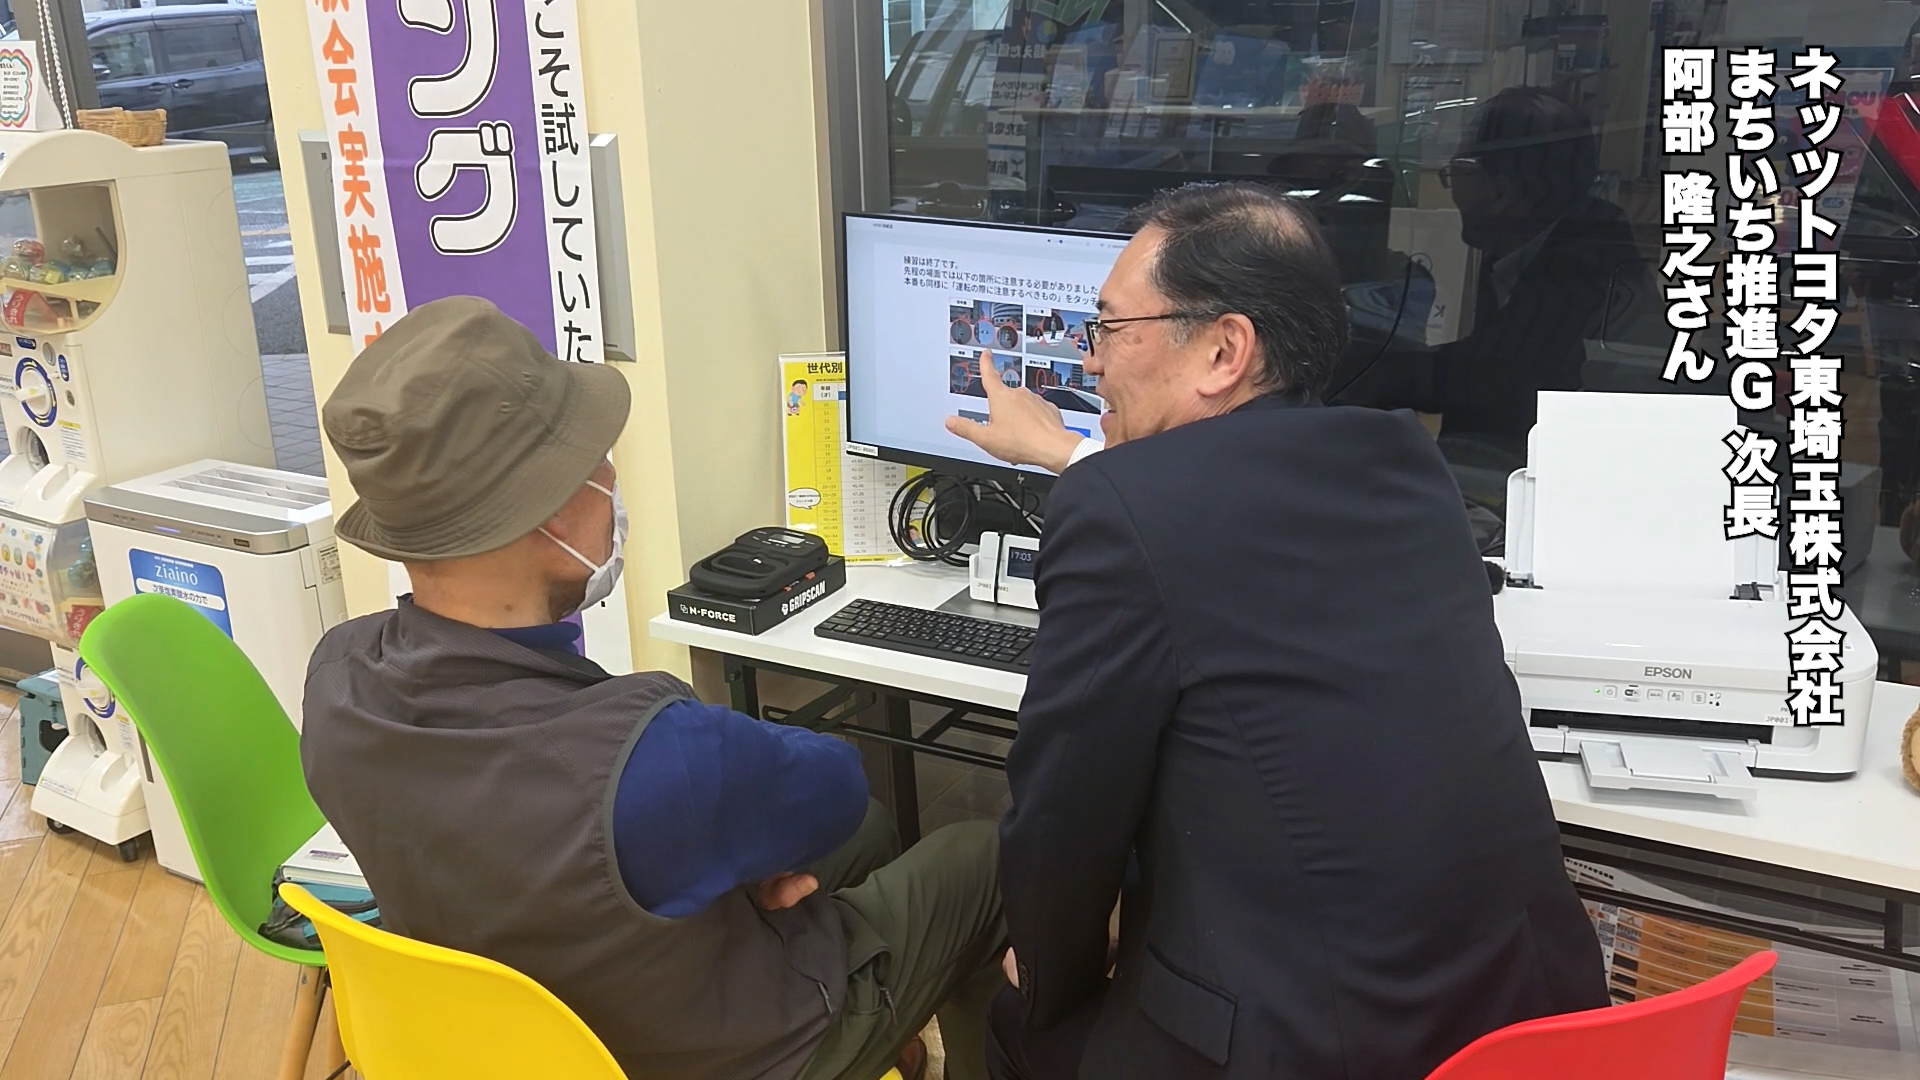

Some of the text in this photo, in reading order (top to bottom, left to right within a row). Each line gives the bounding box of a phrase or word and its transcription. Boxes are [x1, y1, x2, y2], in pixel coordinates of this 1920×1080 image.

[314, 0, 391, 350] 会実施
[903, 256, 959, 270] 練習は終了です。
[807, 362, 843, 374] 世代別
[1010, 551, 1032, 562] 17:03
[155, 563, 198, 586] ziaino
[789, 580, 826, 612] GRIPSCAN
[1644, 666, 1692, 680] EPSON
